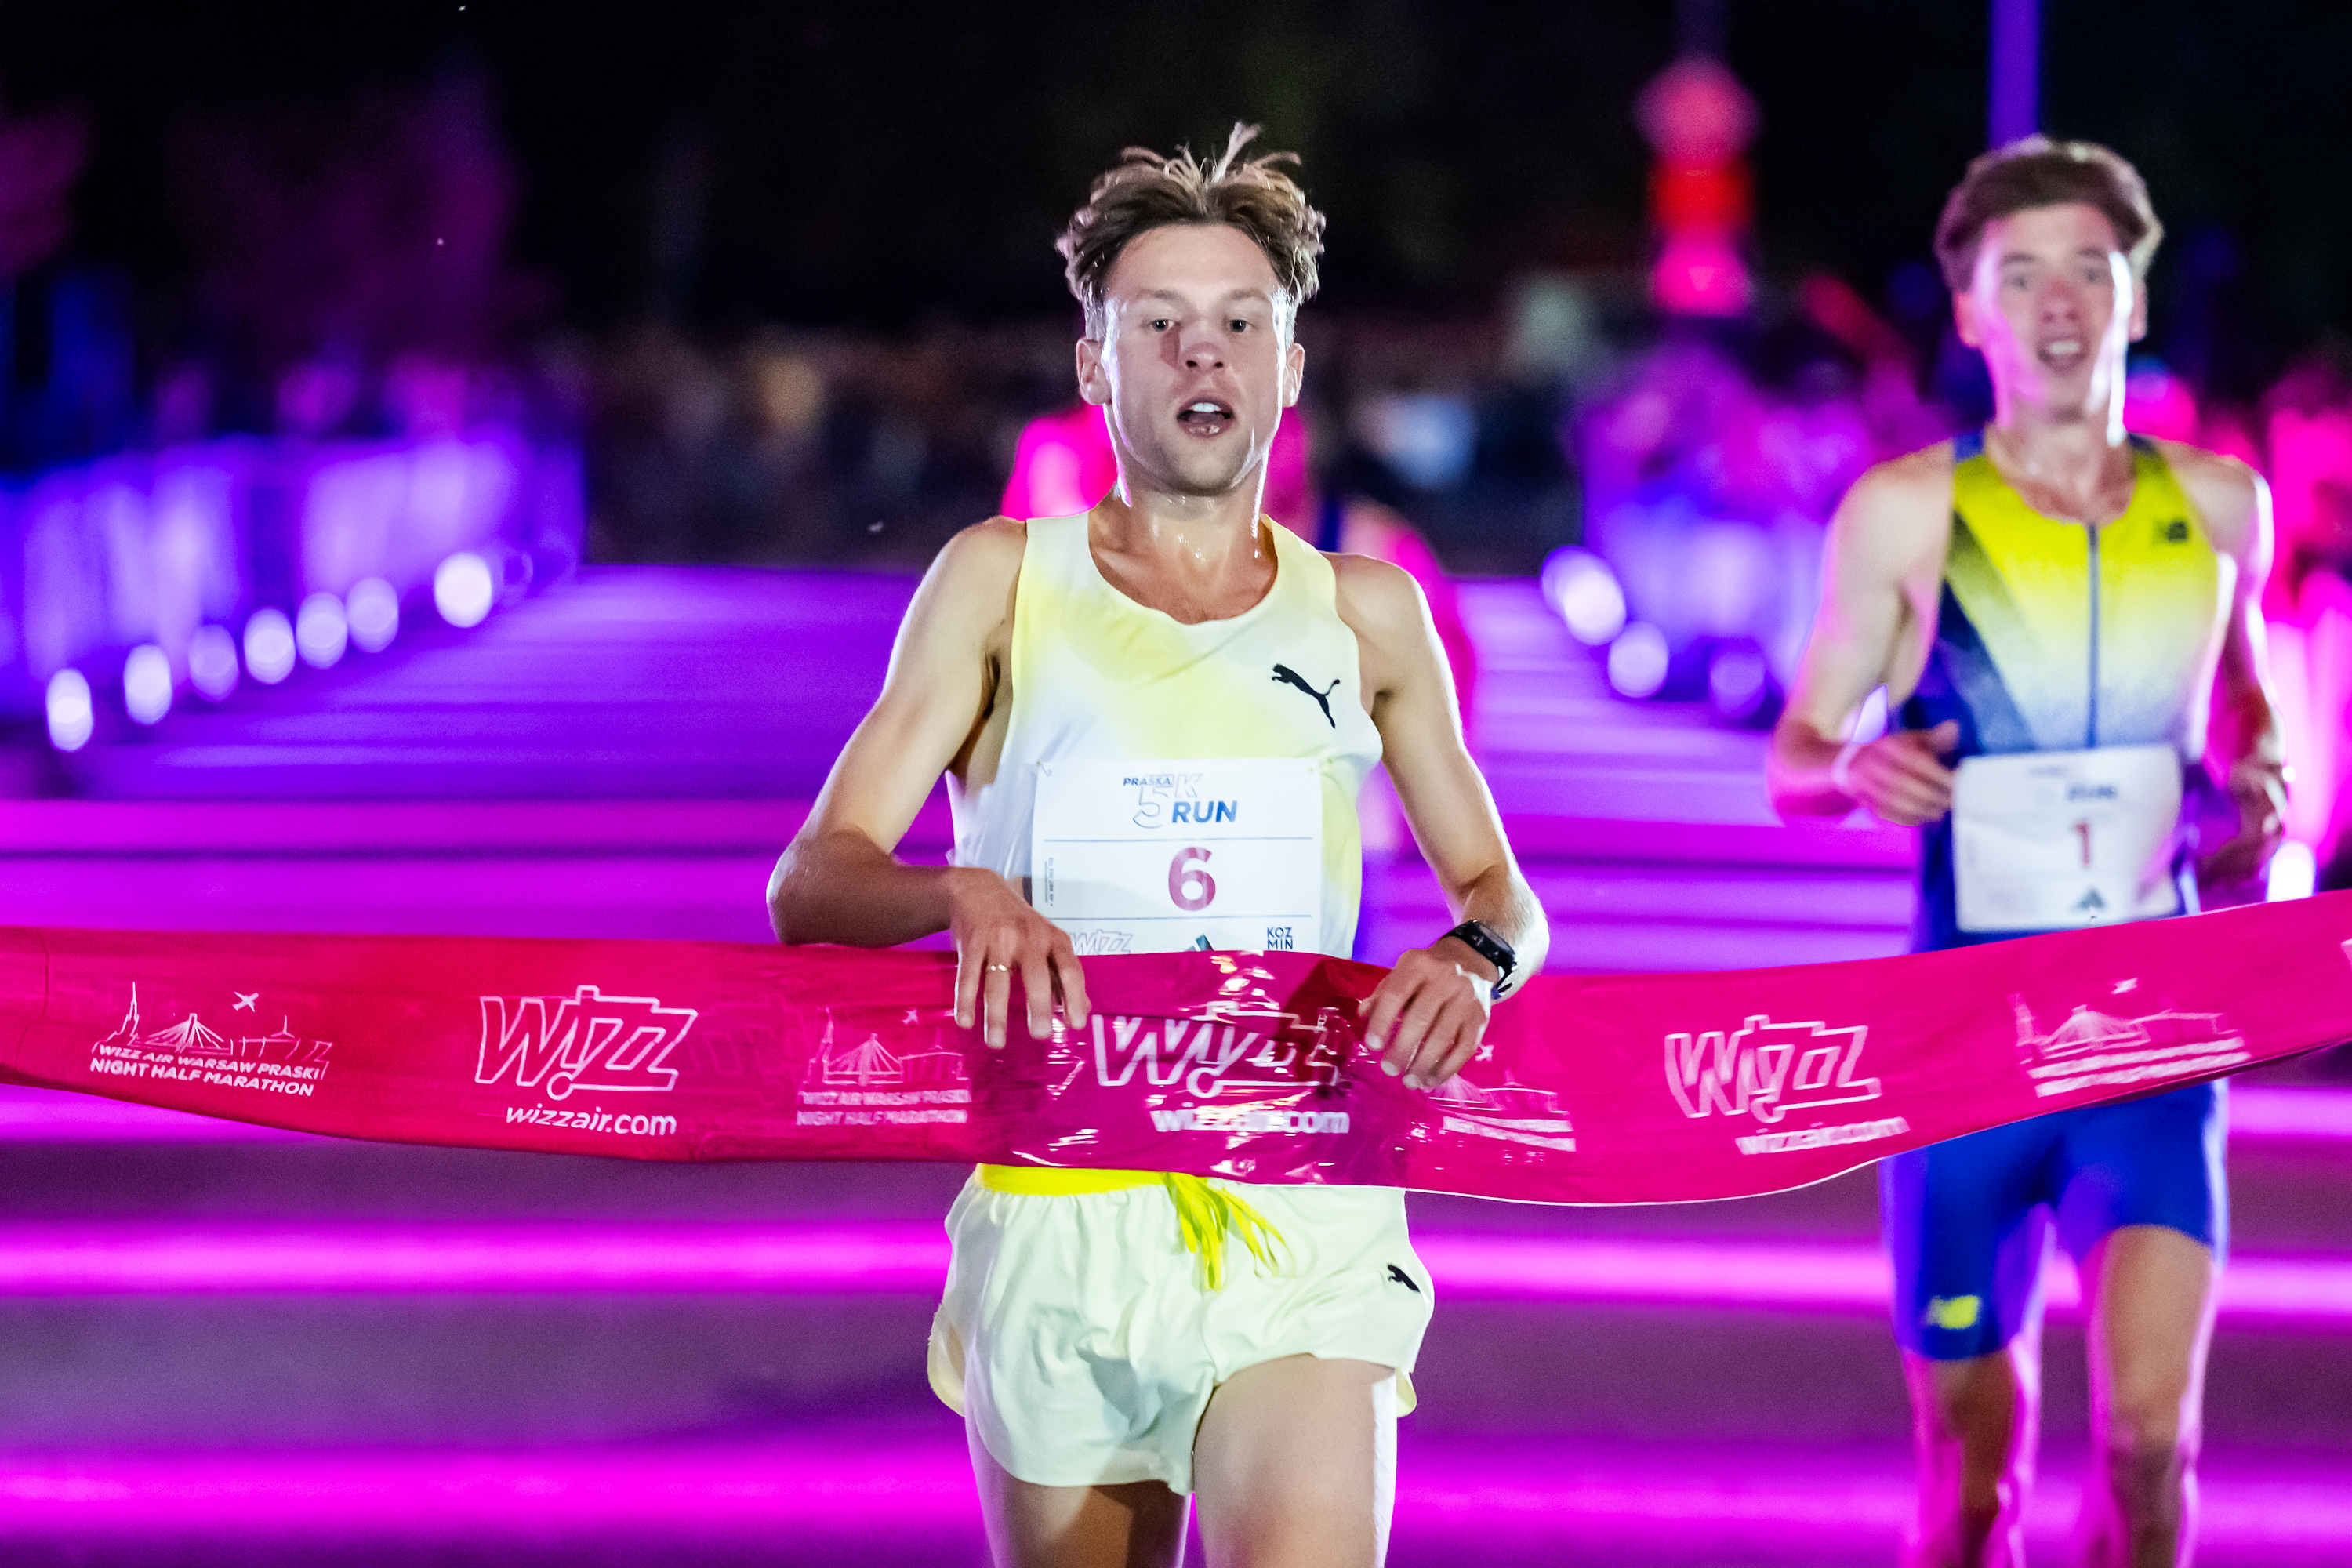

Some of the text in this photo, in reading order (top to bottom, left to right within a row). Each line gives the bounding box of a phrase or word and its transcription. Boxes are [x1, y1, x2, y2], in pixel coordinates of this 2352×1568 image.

[1123, 776, 1172, 786] PRASKA
[1171, 799, 1238, 824] RUN
[2073, 822, 2092, 866] 1
[1167, 846, 1217, 912] 6
[1266, 927, 1292, 938] KOZ
[1267, 938, 1293, 950] MIN
[89, 1057, 314, 1098] NIGHT HALF MARATHON
[100, 1044, 321, 1080] WIZZ AIR WARSAW PRASKI
[506, 1102, 677, 1136] wizzair.com
